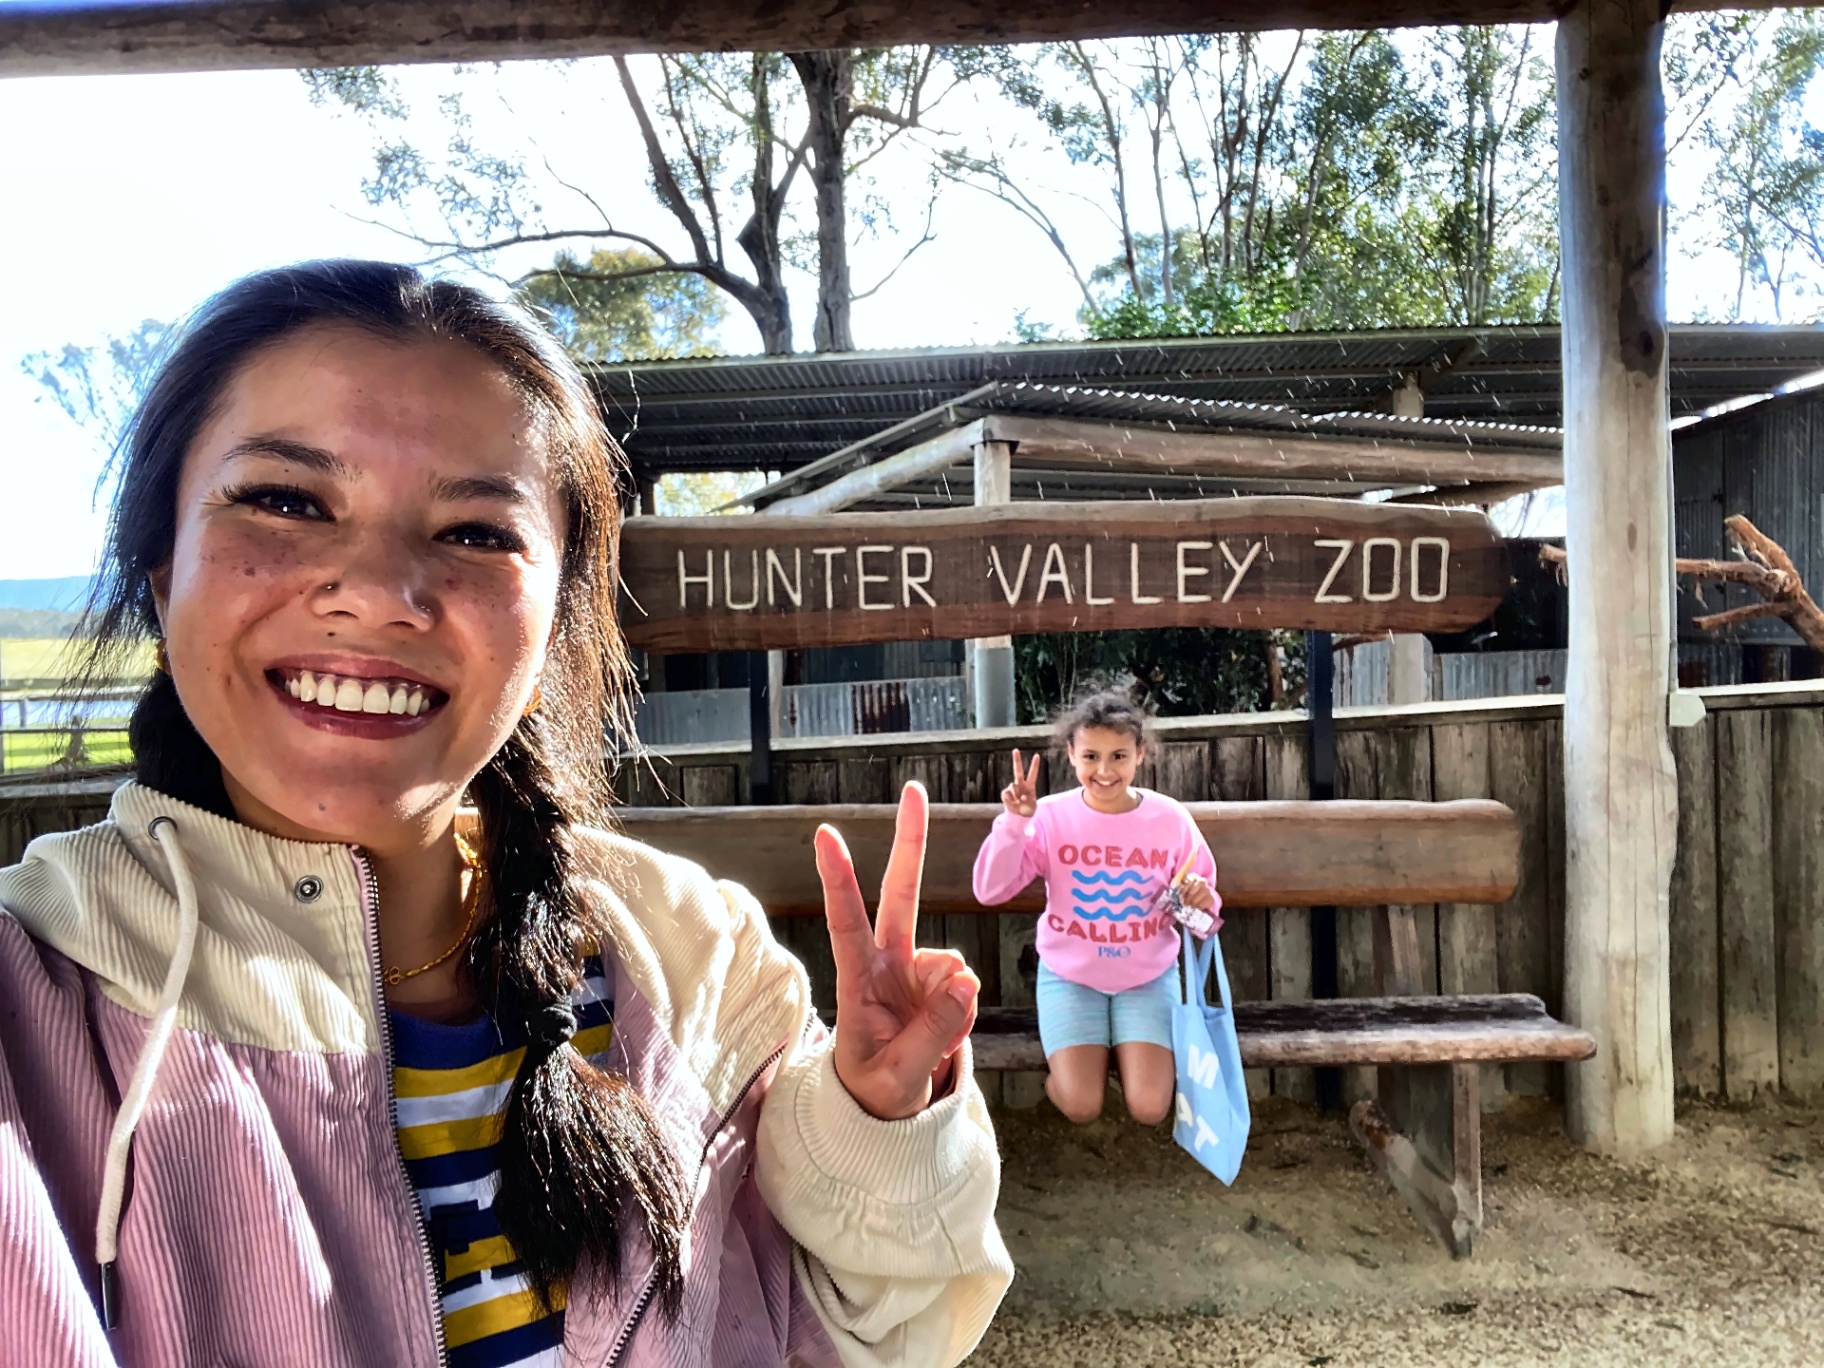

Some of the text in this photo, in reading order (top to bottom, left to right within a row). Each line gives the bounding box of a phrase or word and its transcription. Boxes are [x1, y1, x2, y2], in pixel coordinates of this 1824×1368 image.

[677, 536, 1451, 611] HUNTER VALLEY ZOO
[1058, 844, 1168, 869] OCEAN
